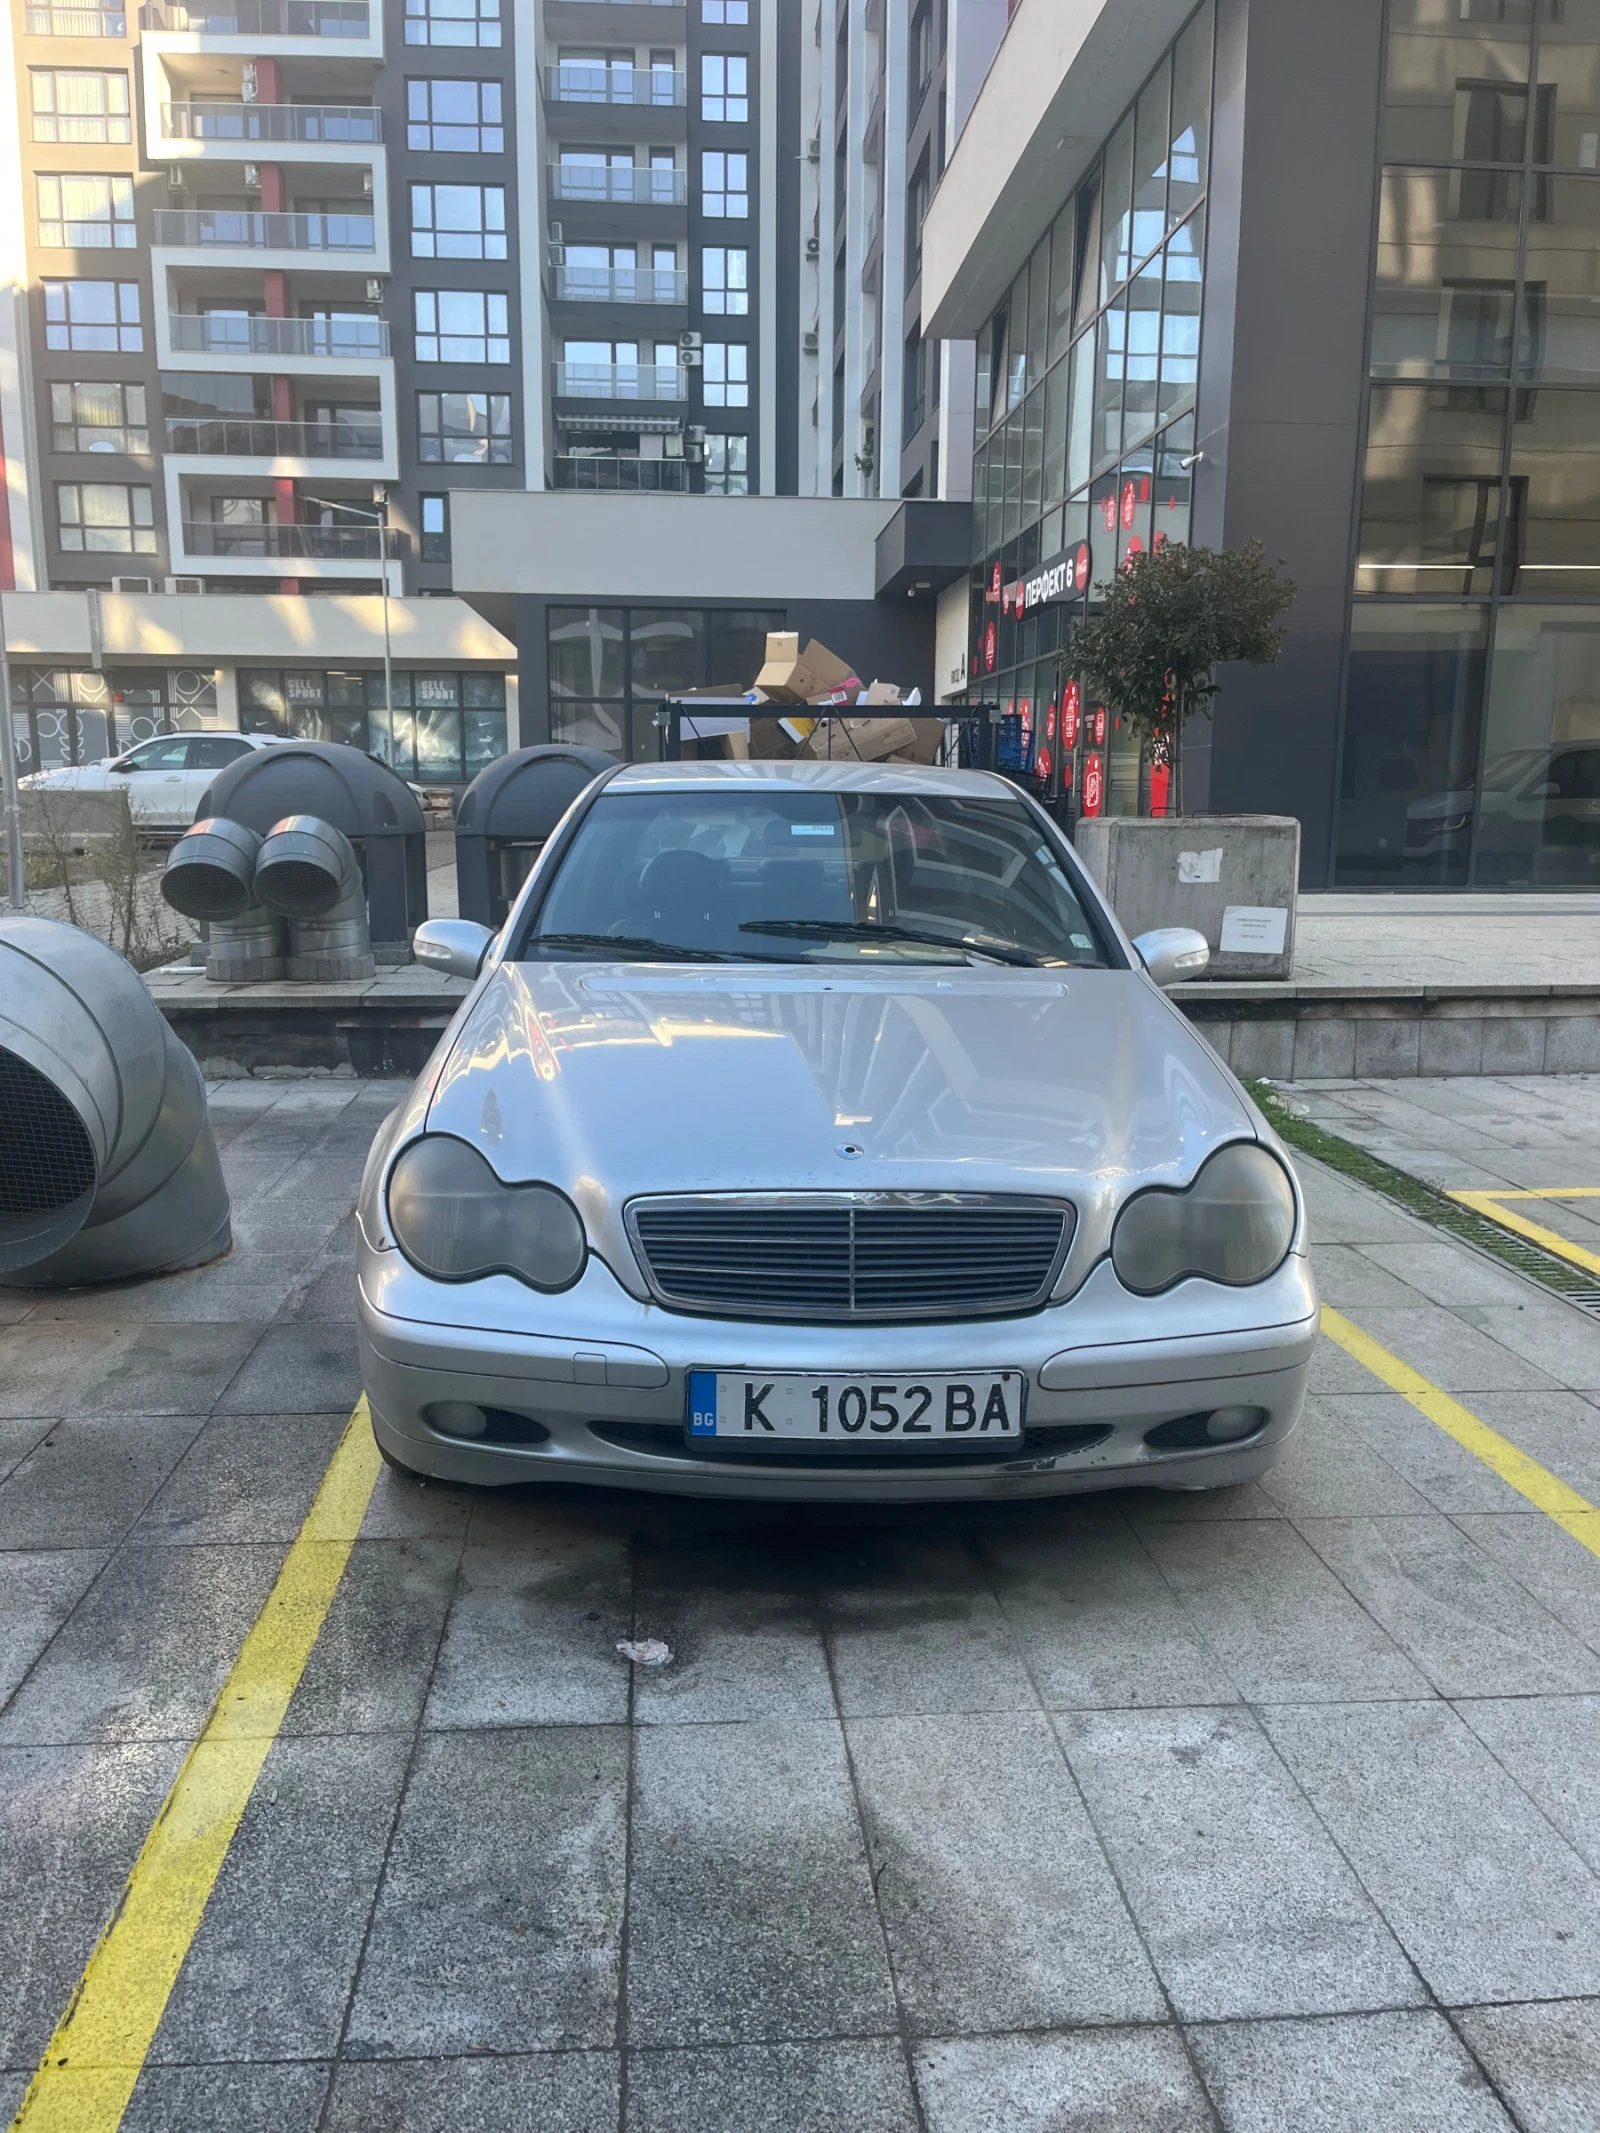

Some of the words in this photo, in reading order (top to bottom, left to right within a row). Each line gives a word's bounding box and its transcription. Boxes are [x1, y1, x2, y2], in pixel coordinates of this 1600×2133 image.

[1025, 562, 1066, 609] ПЕРФЕКТ
[1066, 558, 1074, 588] 6
[288, 688, 321, 699] SPORT
[422, 689, 454, 700] SPORT
[743, 1381, 775, 1432] K
[811, 1384, 932, 1434] 1052
[944, 1383, 1011, 1432] BA
[693, 1411, 714, 1427] BG
